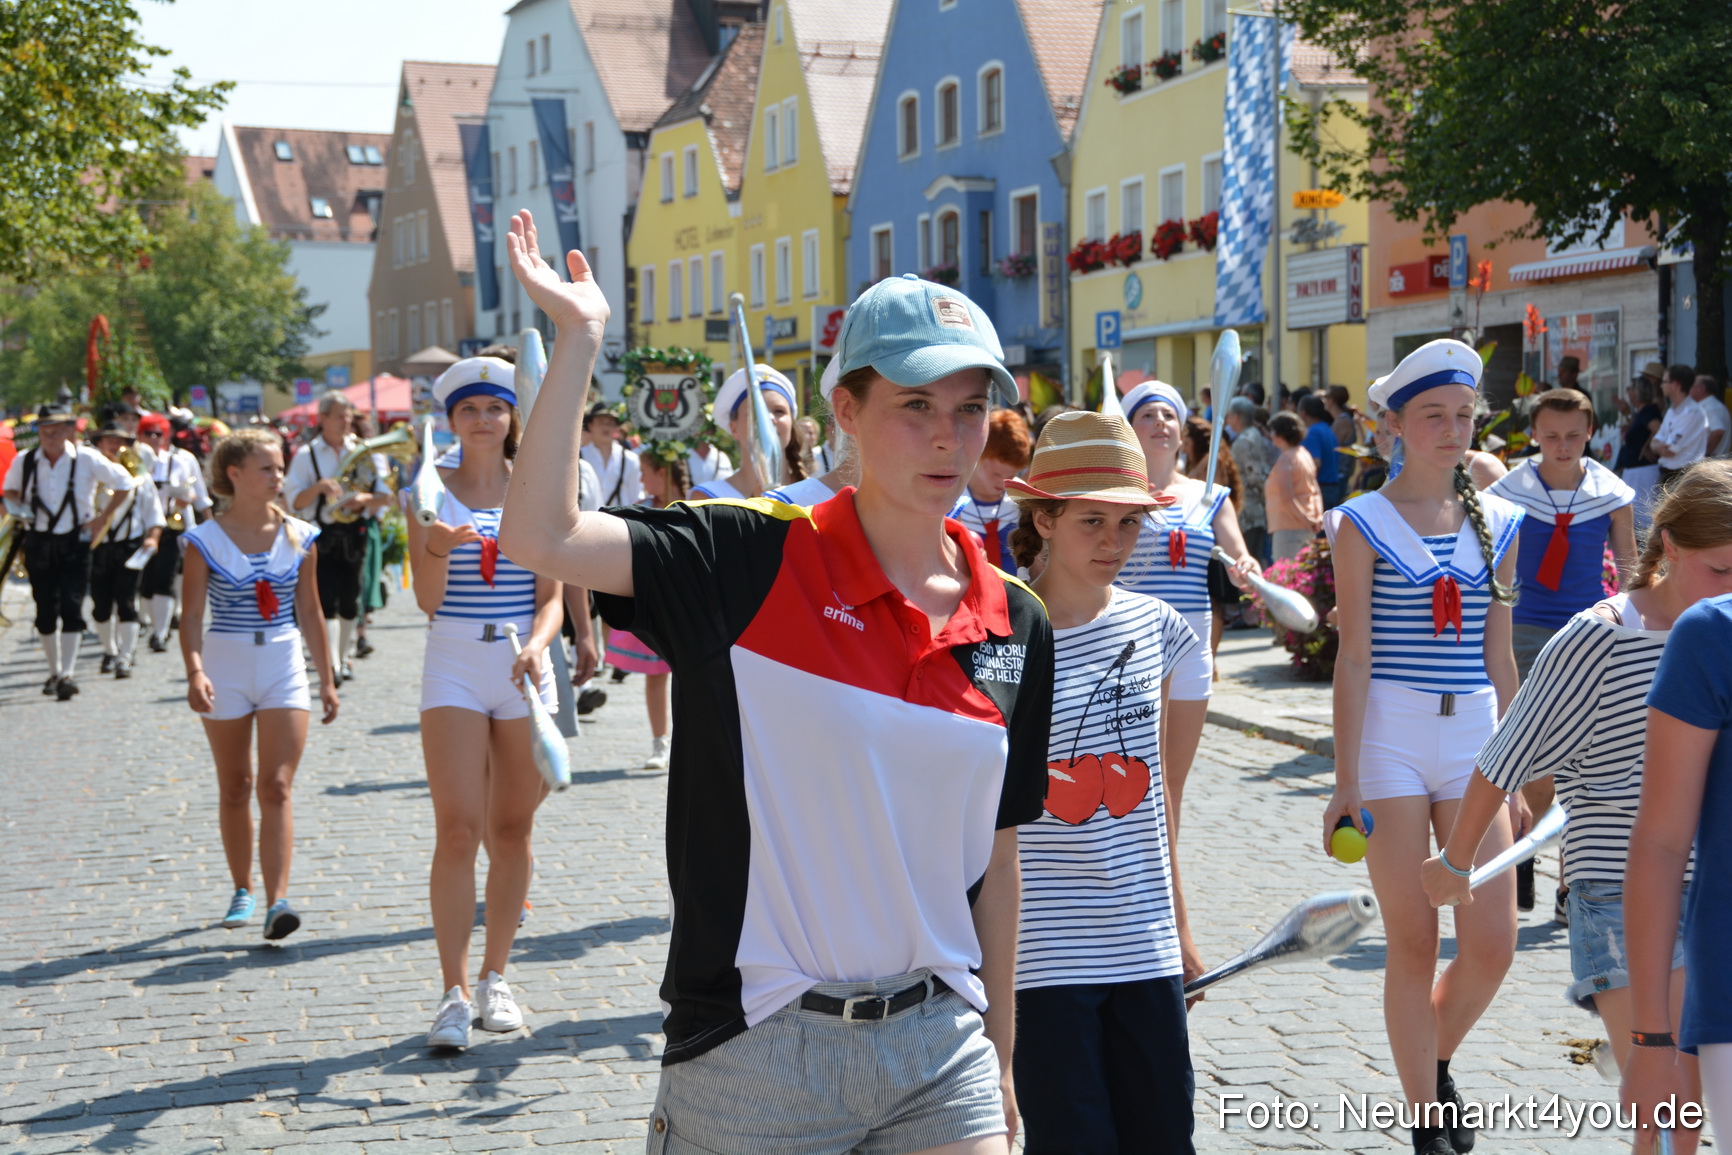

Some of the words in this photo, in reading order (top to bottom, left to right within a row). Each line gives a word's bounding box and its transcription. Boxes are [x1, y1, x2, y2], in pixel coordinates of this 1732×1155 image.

[1350, 248, 1361, 319] KINO
[1101, 314, 1117, 346] P
[823, 606, 865, 632] erima
[974, 665, 995, 681] 2015
[1105, 701, 1156, 737] forever
